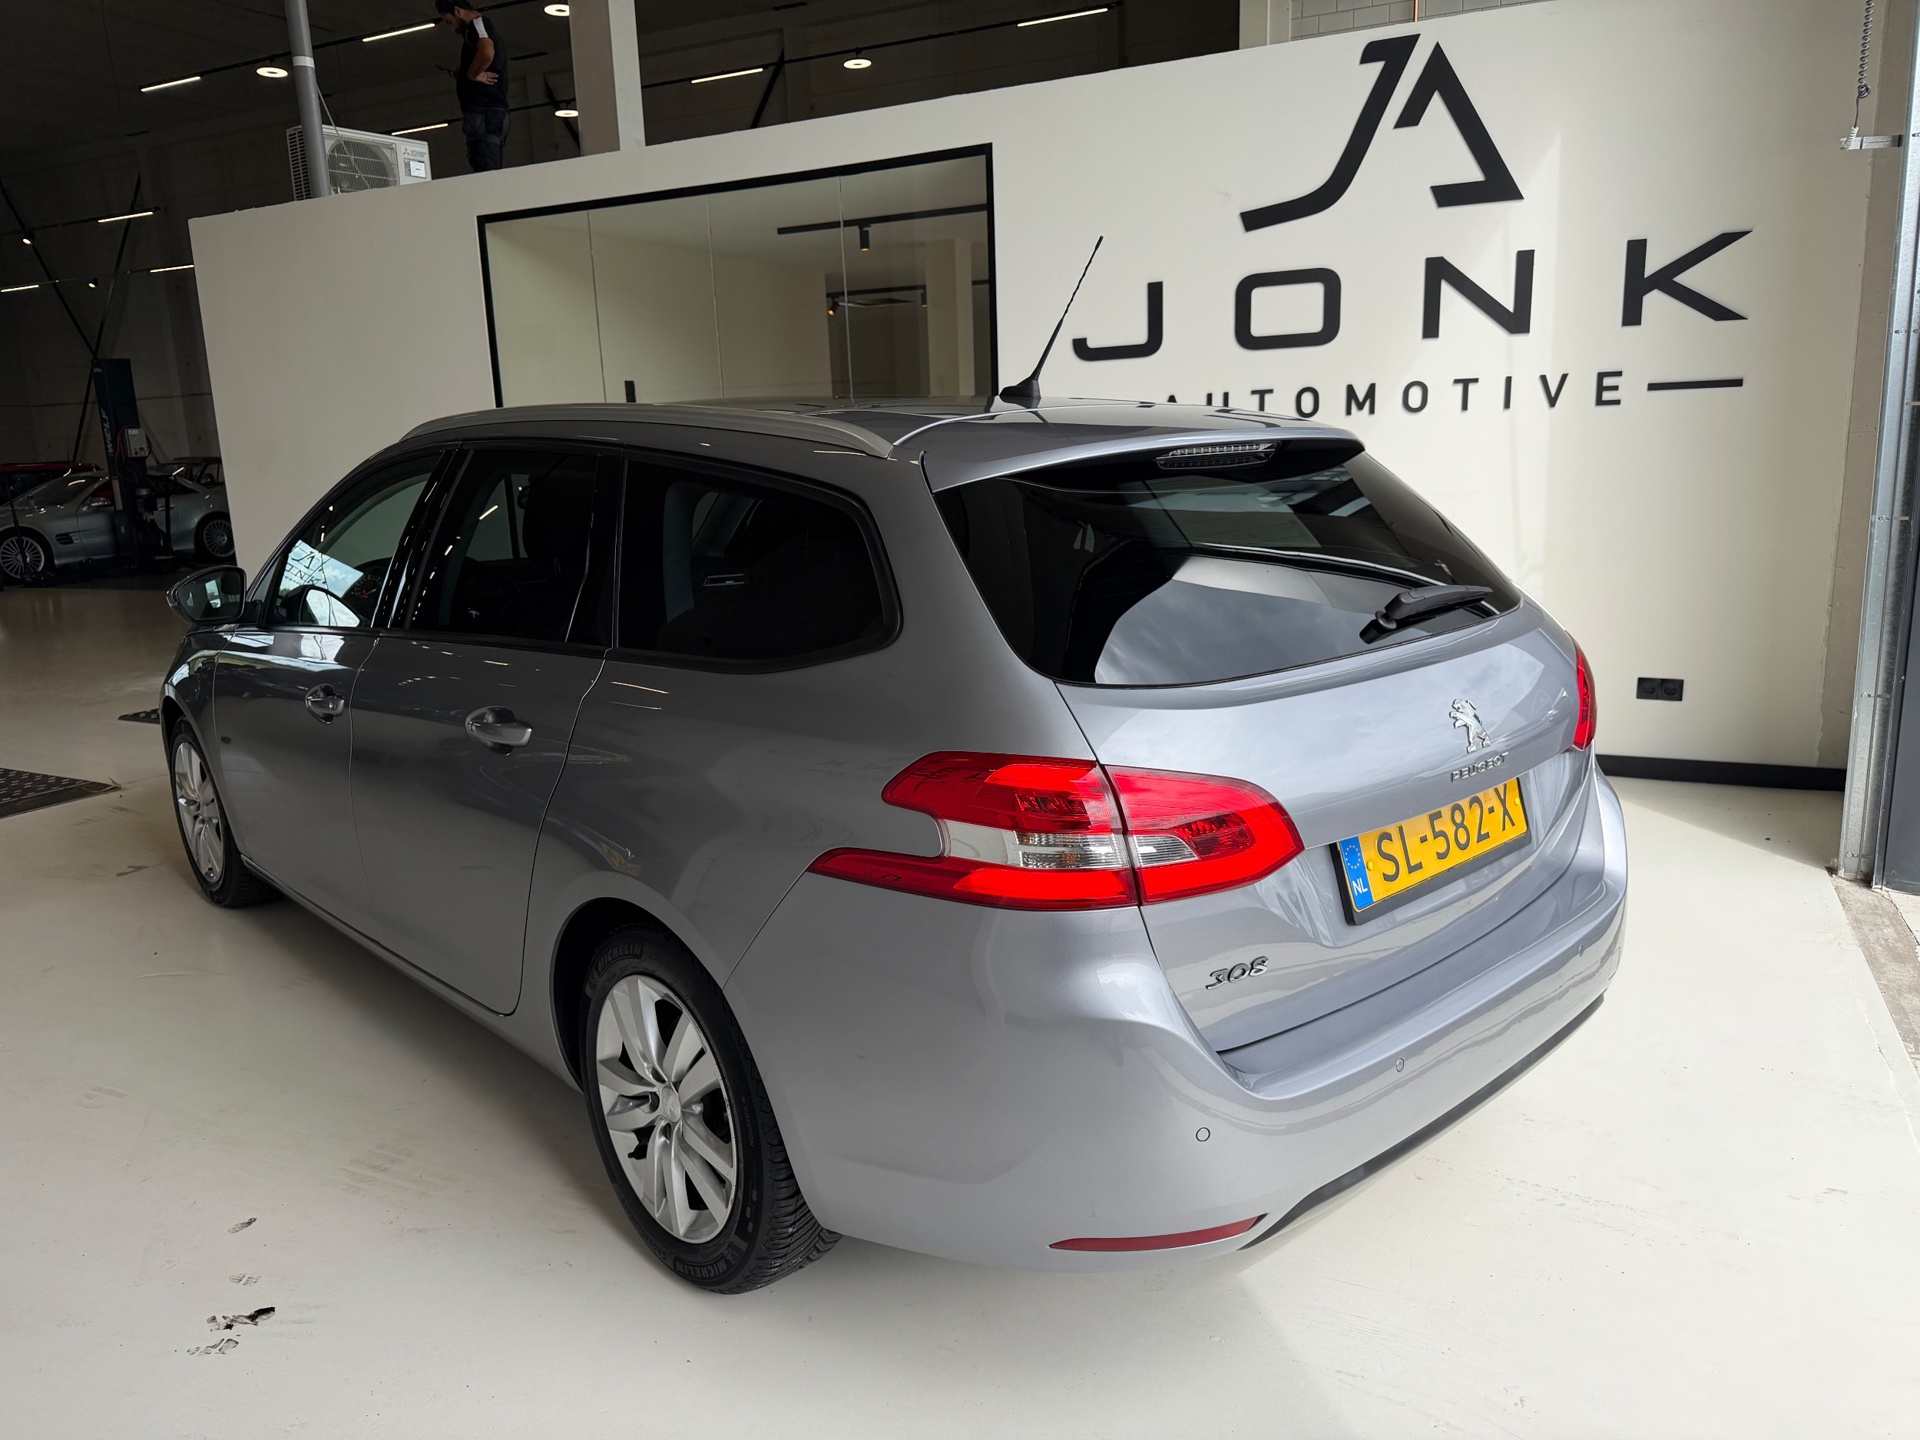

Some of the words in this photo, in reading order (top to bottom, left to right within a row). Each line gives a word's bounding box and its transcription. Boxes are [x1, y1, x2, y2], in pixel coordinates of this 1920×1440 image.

[1072, 229, 1754, 363] JONK
[1166, 369, 1625, 419] TOMOTIVE
[1450, 751, 1509, 783] PEUGEOT
[1376, 783, 1516, 883] SL-582-X
[1351, 877, 1369, 897] NL
[597, 942, 643, 973] MICHELIN
[1205, 955, 1270, 990] 308
[676, 1257, 728, 1280] MICHELIN
